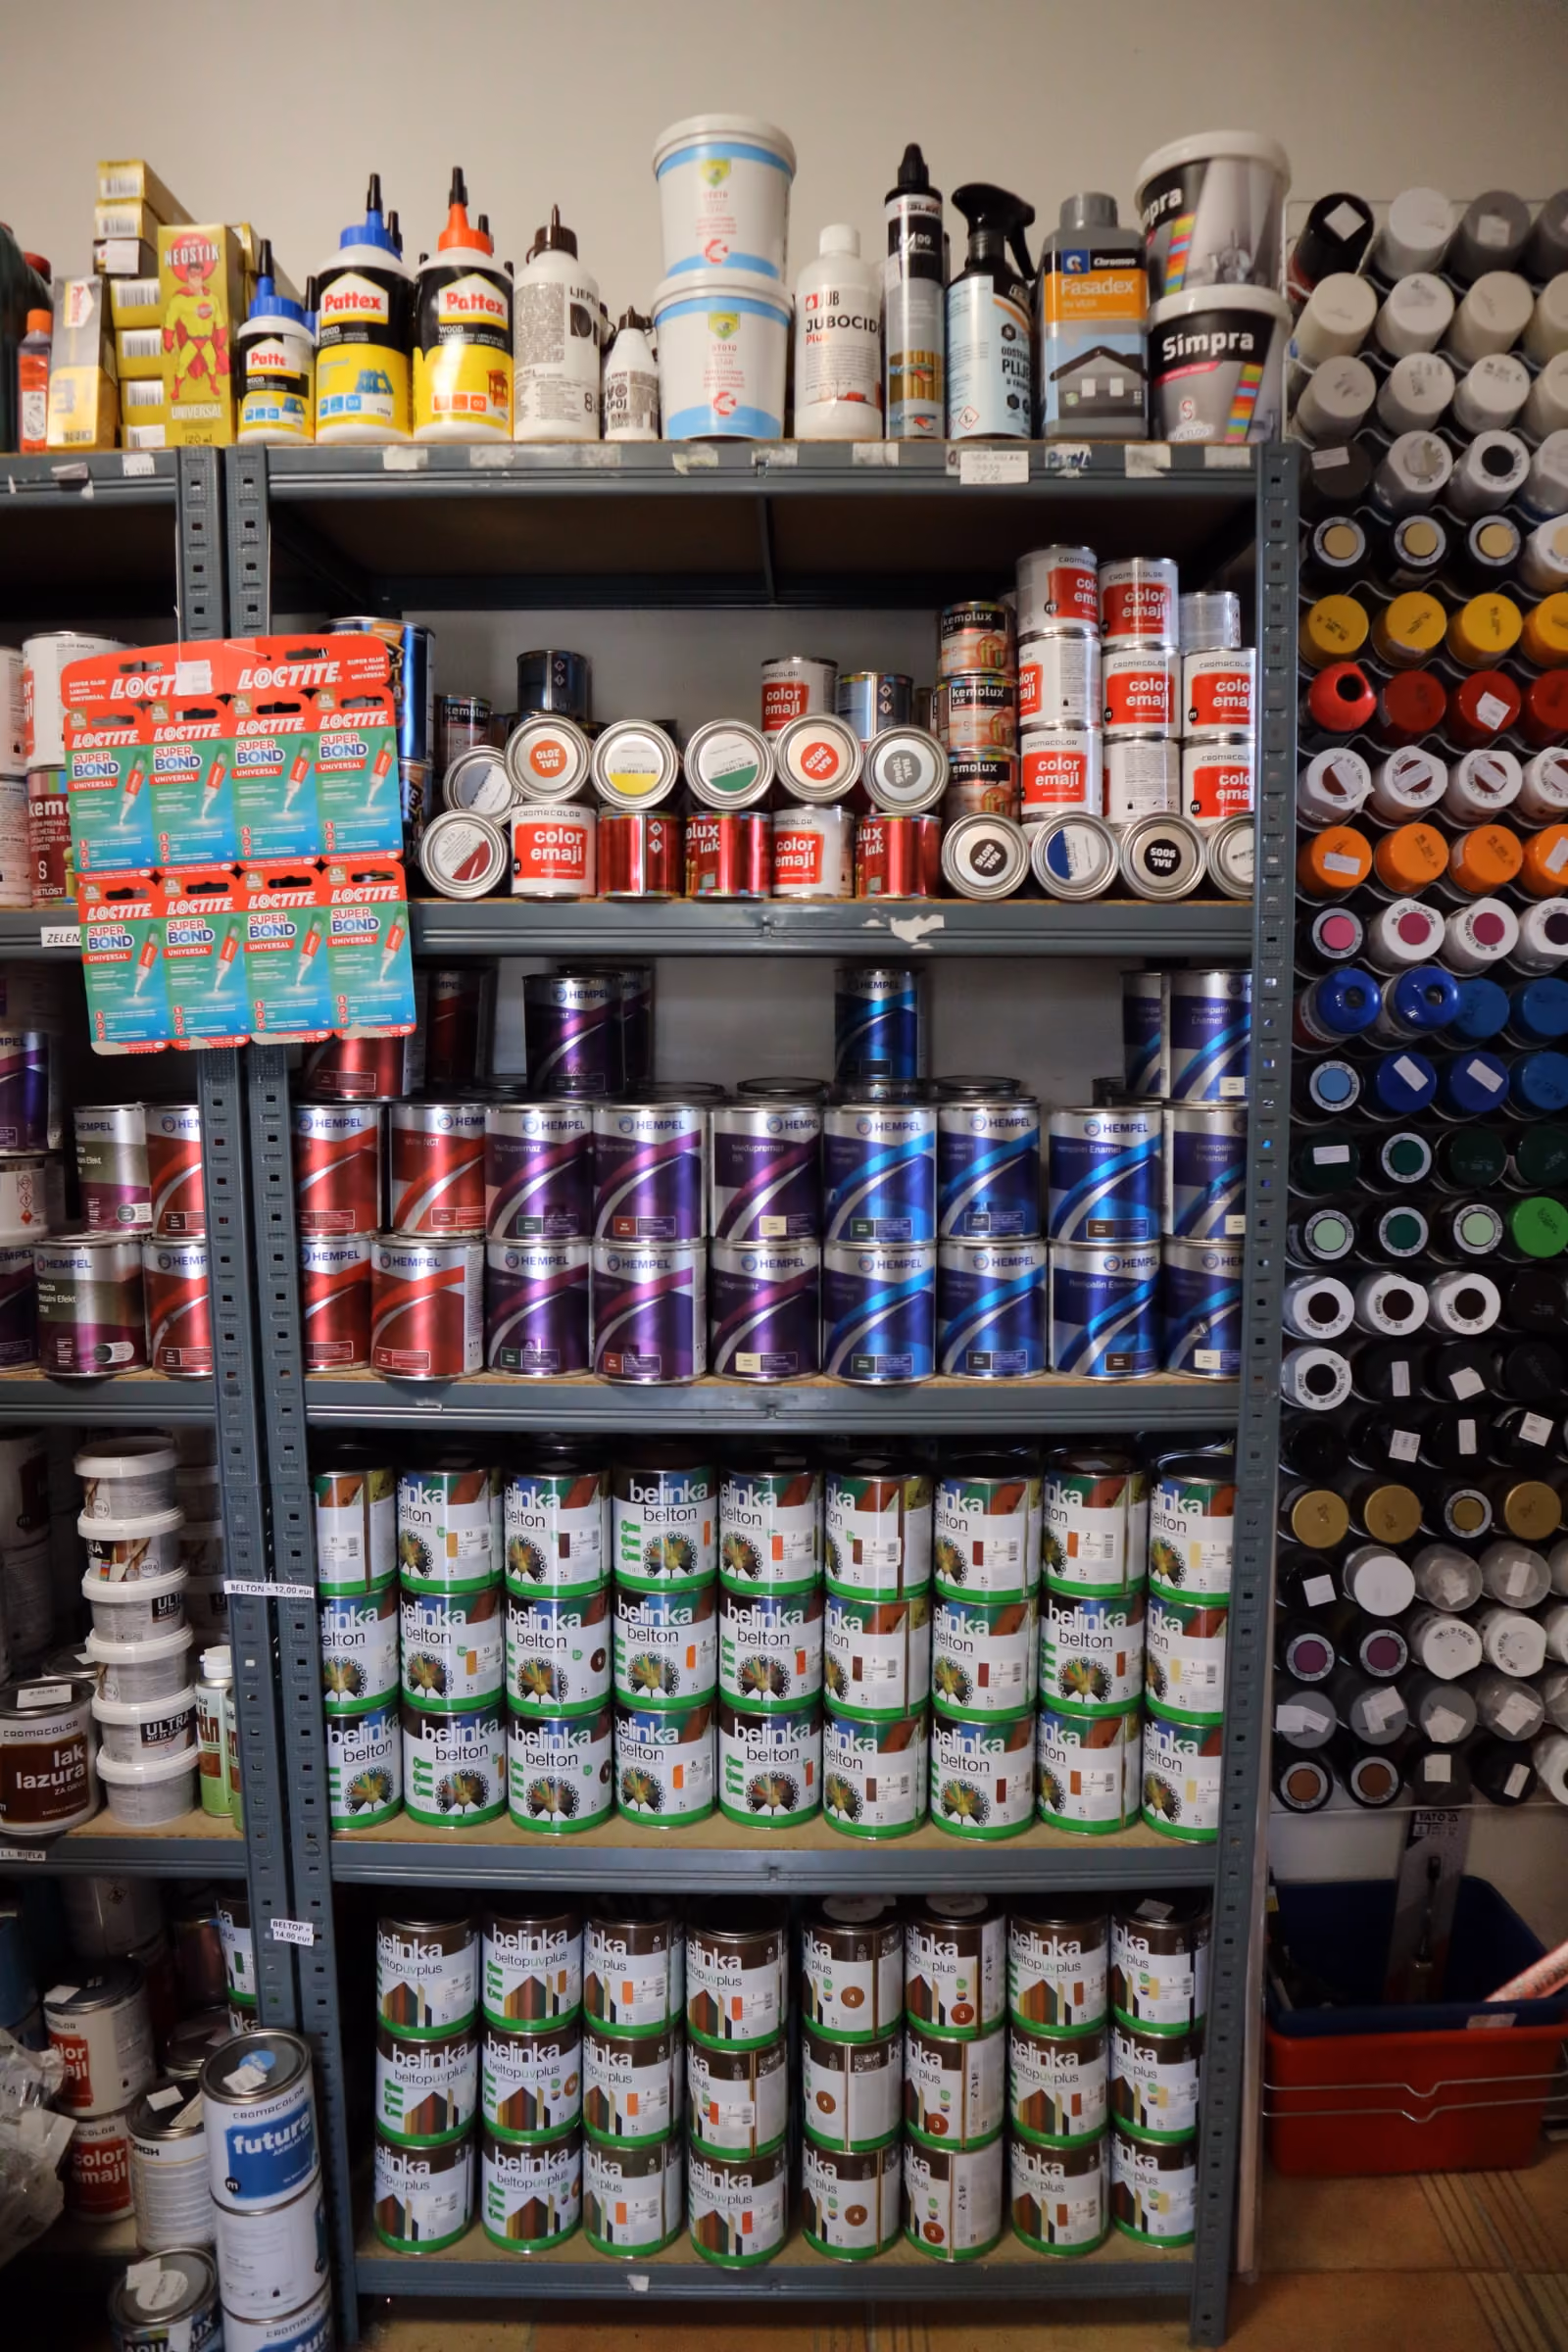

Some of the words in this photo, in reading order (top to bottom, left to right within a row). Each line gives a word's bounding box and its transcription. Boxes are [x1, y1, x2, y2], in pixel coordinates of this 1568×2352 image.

[165, 244, 220, 267] NEOSTIK
[1094, 257, 1137, 268] Chromos
[1060, 278, 1135, 296] Fasadex
[324, 292, 381, 313] Pattex
[446, 292, 505, 317] Pattex
[438, 325, 464, 334] WOOD
[1163, 330, 1254, 362] Simpra
[172, 404, 222, 419] UNIVERSAL
[1124, 590, 1166, 602] color
[1122, 603, 1167, 617] emajl
[943, 612, 993, 625] kemolux
[237, 662, 341, 691] LOCTITE
[766, 684, 801, 700] color
[1129, 677, 1169, 692] color
[952, 686, 1004, 700] kemolux
[1126, 692, 1169, 708] emajl
[765, 700, 800, 715] emajl
[236, 717, 306, 735] LOCTITE
[319, 710, 388, 729] LOCTITE
[72, 730, 139, 749] LOCTITE
[154, 723, 220, 742] LOCTITE
[320, 734, 358, 745] SUPER
[155, 746, 191, 757] SUPER
[237, 741, 275, 751] SUPER
[320, 744, 368, 758] BOND
[536, 748, 561, 759] 2010
[74, 753, 110, 763] SUPER
[155, 757, 200, 770] BOND
[237, 751, 284, 764] BOND
[805, 746, 828, 769] 3020
[814, 757, 833, 773] RAL
[1038, 759, 1080, 771] color
[74, 762, 119, 777] BOND
[320, 761, 362, 770] UNIVERSAL
[74, 780, 114, 789] UNIVERSAL
[155, 774, 194, 783] UNIVERSAL
[1035, 772, 1079, 788] emajl
[534, 827, 583, 844] color
[700, 839, 721, 854] lak
[776, 838, 815, 852] color
[1150, 847, 1176, 858] 9005
[530, 846, 582, 865] emajl
[775, 854, 815, 869] emajl
[983, 852, 1002, 869] RAL
[1152, 858, 1173, 868] RAL
[248, 891, 317, 909] LOCTITE
[331, 885, 400, 904] LOCTITE
[87, 903, 152, 921] LOCTITE
[167, 898, 233, 915] LOCTITE
[332, 908, 369, 919] SUPER
[168, 920, 204, 931] SUPER
[249, 914, 286, 925] SUPER
[332, 918, 379, 932] BOND
[47, 933, 82, 944] ZELEN
[88, 926, 124, 937] SUPER
[168, 930, 214, 944] BOND
[249, 924, 296, 938] BOND
[88, 935, 133, 950] BOND
[316, 1117, 363, 1129] HEMPEL
[541, 1120, 586, 1130] HEMPEL
[637, 1120, 685, 1130] HEMPEL
[875, 1121, 921, 1131] HEMPEL
[989, 1117, 1031, 1128] HEMPEL
[1103, 1123, 1149, 1133] HEMPEL
[313, 1250, 361, 1261] HEMPEL
[393, 1256, 441, 1267] HEMPEL
[520, 1255, 569, 1266] HEMPEL
[760, 1257, 806, 1269] HEMPEL
[992, 1256, 1036, 1266] HEMPEL
[46, 1258, 92, 1269] HEMPEL
[621, 1259, 670, 1269] HEMPEL
[877, 1259, 922, 1269] HEMPEL
[629, 1478, 708, 1504] belinka
[644, 1507, 697, 1522] belton
[230, 1584, 265, 1592] BELTON
[401, 1592, 466, 1626] belinka
[509, 1599, 581, 1631] belinka
[618, 1594, 693, 1625] belinka
[727, 1597, 804, 1628] belinka
[1049, 1599, 1126, 1631] belinka
[406, 1624, 451, 1644] belton
[516, 1629, 567, 1648] belton
[627, 1626, 678, 1642] belton
[737, 1628, 790, 1647] belton
[1059, 1629, 1113, 1648] belton
[326, 1714, 400, 1745] belinka
[421, 1717, 499, 1743] belinka
[514, 1722, 591, 1749] belinka
[734, 1718, 810, 1744] belinka
[934, 1718, 1004, 1756] belinka
[54, 1744, 85, 1768] lak
[343, 1739, 392, 1763] belton
[435, 1743, 488, 1761] belton
[619, 1740, 664, 1760] belton
[746, 1744, 800, 1762] belton
[526, 1749, 578, 1767] belton
[940, 1749, 990, 1772] belton
[16, 1763, 86, 1789] lazura
[272, 1920, 304, 1932] BELTOP
[493, 1923, 567, 1951] belinka
[1010, 1921, 1082, 1956] belinka
[393, 2041, 467, 2068] belinka
[487, 2031, 561, 2063] belinka
[233, 2112, 312, 2156] futura
[495, 2146, 569, 2174] belinka
